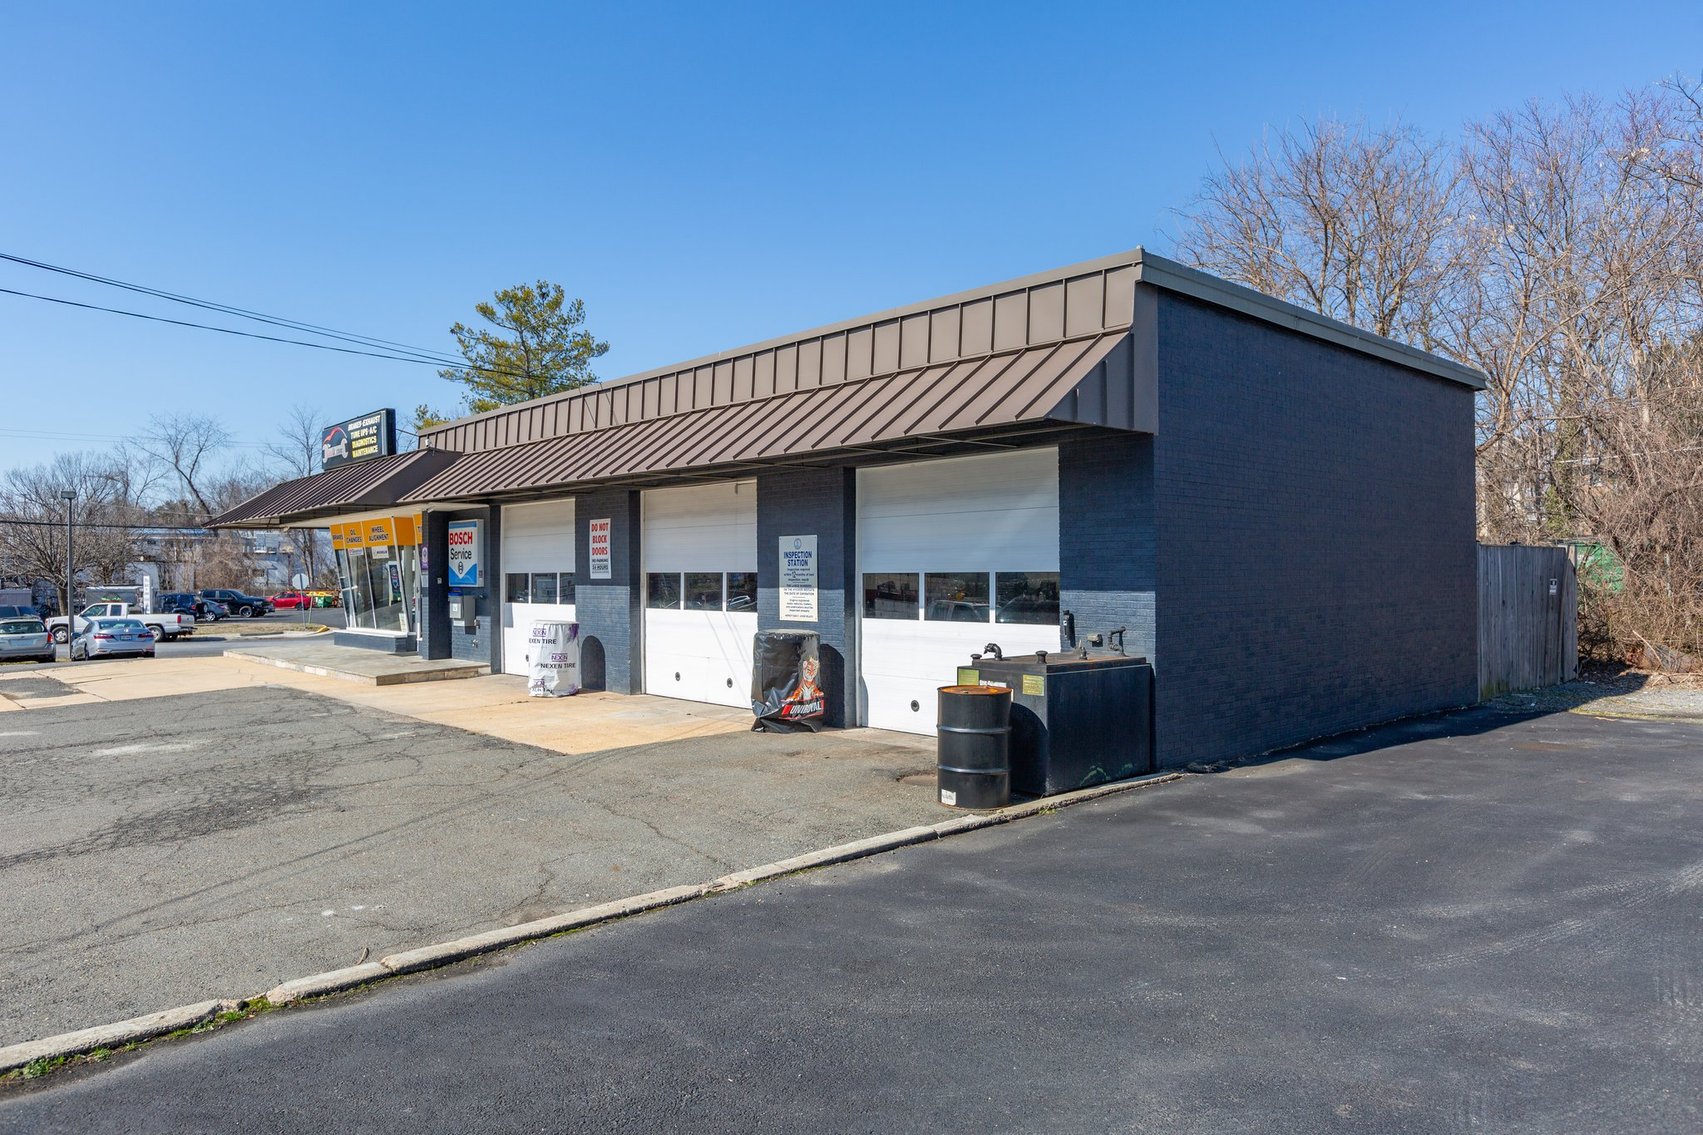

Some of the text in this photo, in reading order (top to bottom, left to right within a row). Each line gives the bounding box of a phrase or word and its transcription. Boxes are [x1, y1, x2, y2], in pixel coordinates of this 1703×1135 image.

[591, 522, 608, 532] DO NOT
[368, 533, 389, 542] ALIGNMENT
[449, 532, 473, 545] BOSCH
[592, 535, 607, 544] BLOCK
[450, 548, 472, 560] Service
[592, 546, 608, 556] DOORS
[784, 551, 812, 559] INSPECTION
[788, 559, 808, 567] STATION
